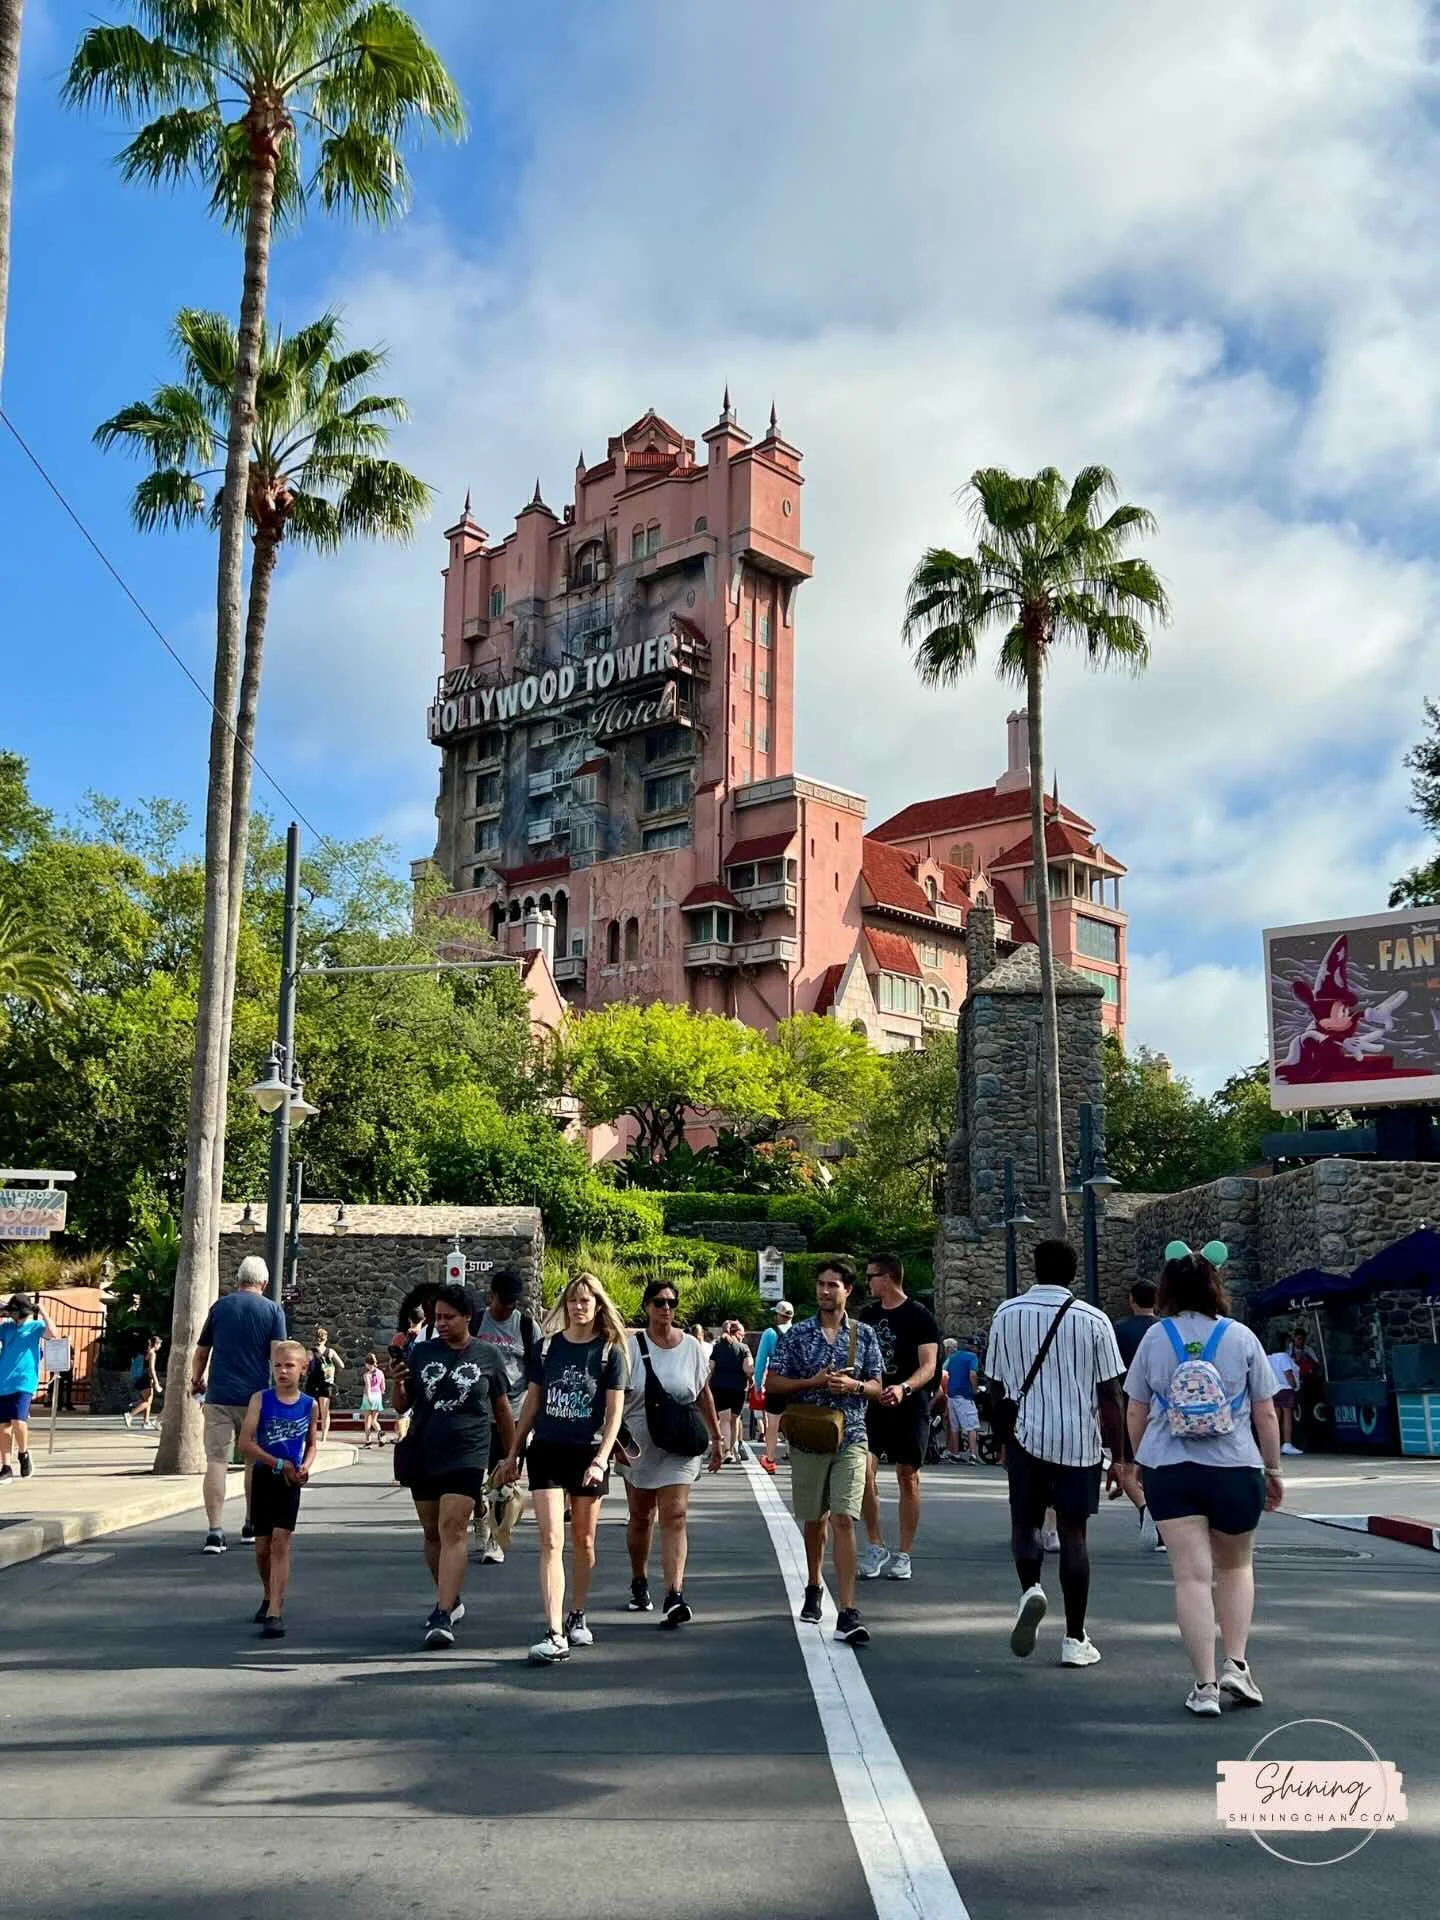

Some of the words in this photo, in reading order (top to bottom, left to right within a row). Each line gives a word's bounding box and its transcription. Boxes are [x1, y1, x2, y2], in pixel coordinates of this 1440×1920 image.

[427, 665, 575, 739] HOLLYWOOD
[584, 632, 679, 689] TOWER
[442, 664, 481, 695] The
[588, 681, 677, 740] Hotel
[469, 1260, 494, 1272] STOP
[546, 1386, 592, 1409] Magic
